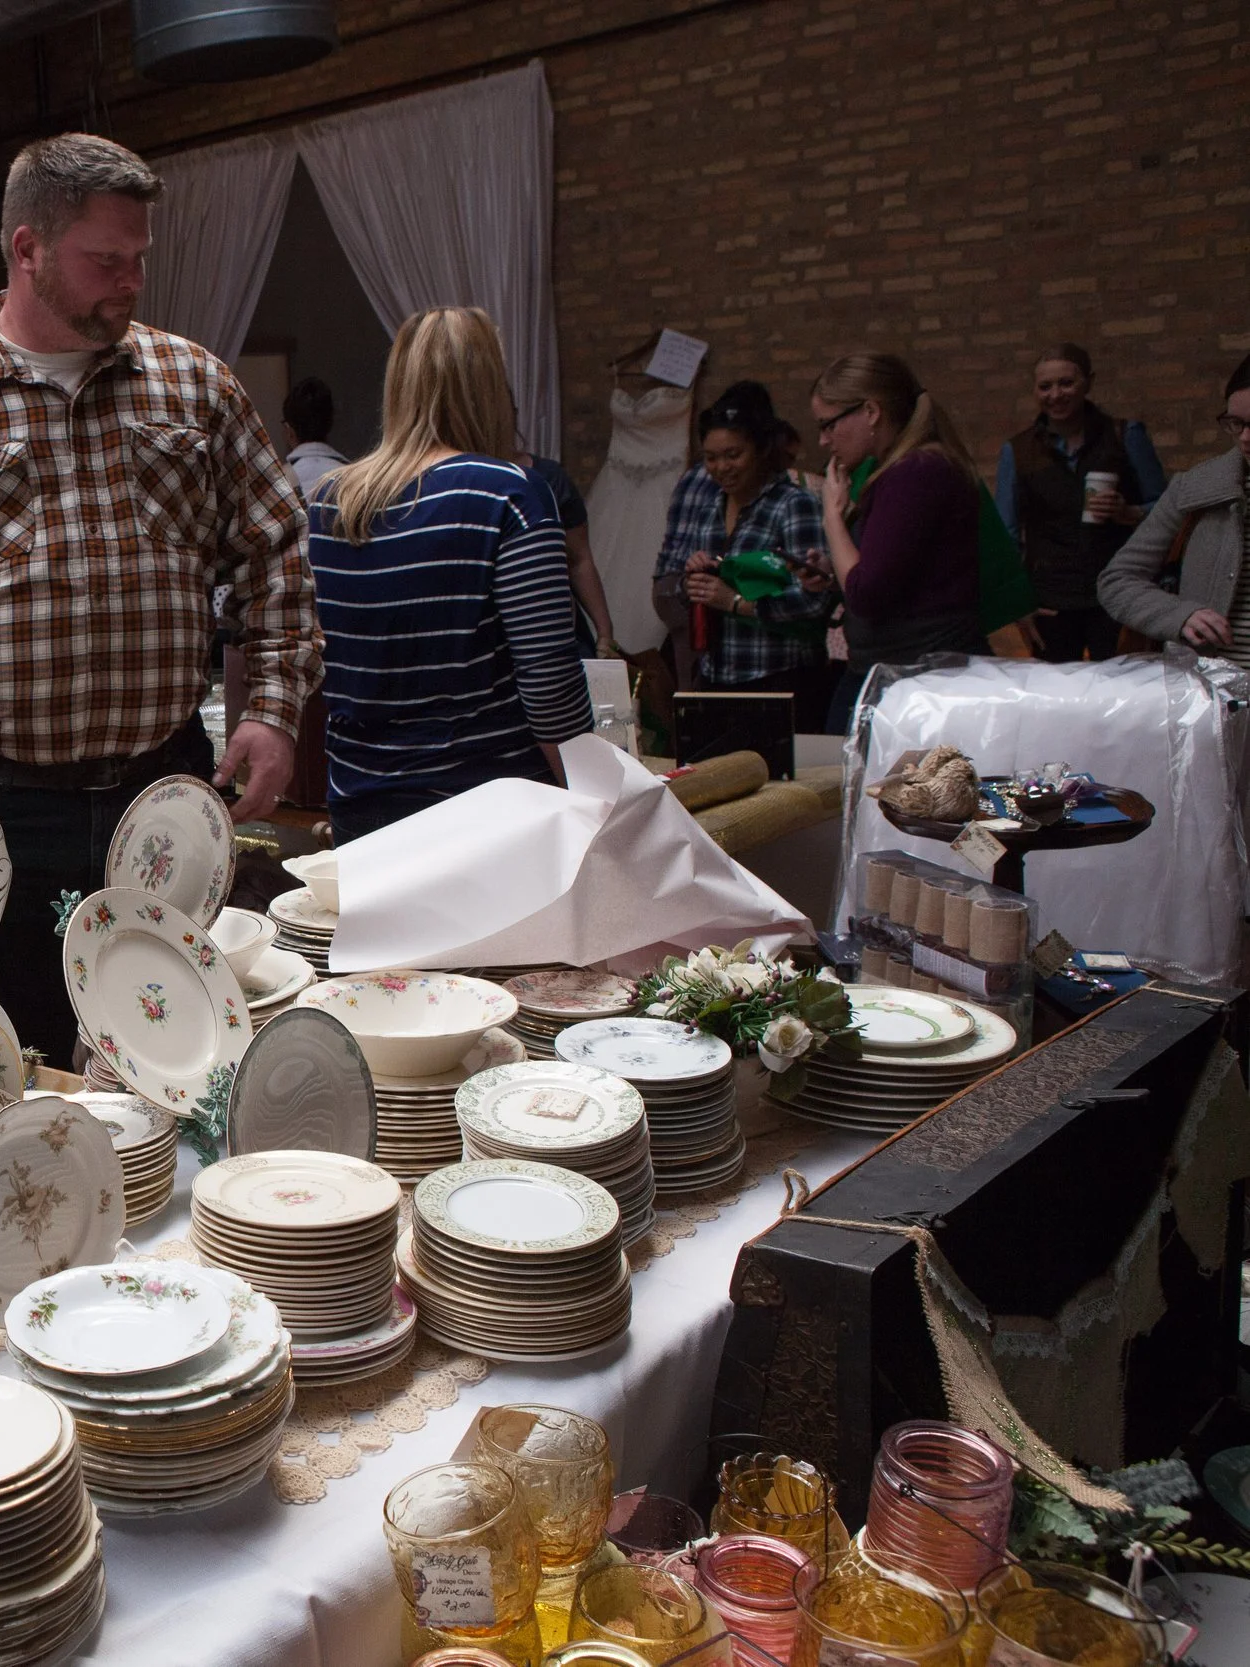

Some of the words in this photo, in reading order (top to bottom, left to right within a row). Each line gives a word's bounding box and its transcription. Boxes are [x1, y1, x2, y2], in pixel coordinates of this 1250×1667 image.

[453, 1555, 479, 1572] Gate
[436, 1578, 456, 1586] Vintage
[431, 1586, 461, 1596] Votive
[441, 1599, 471, 1612] $2.00
